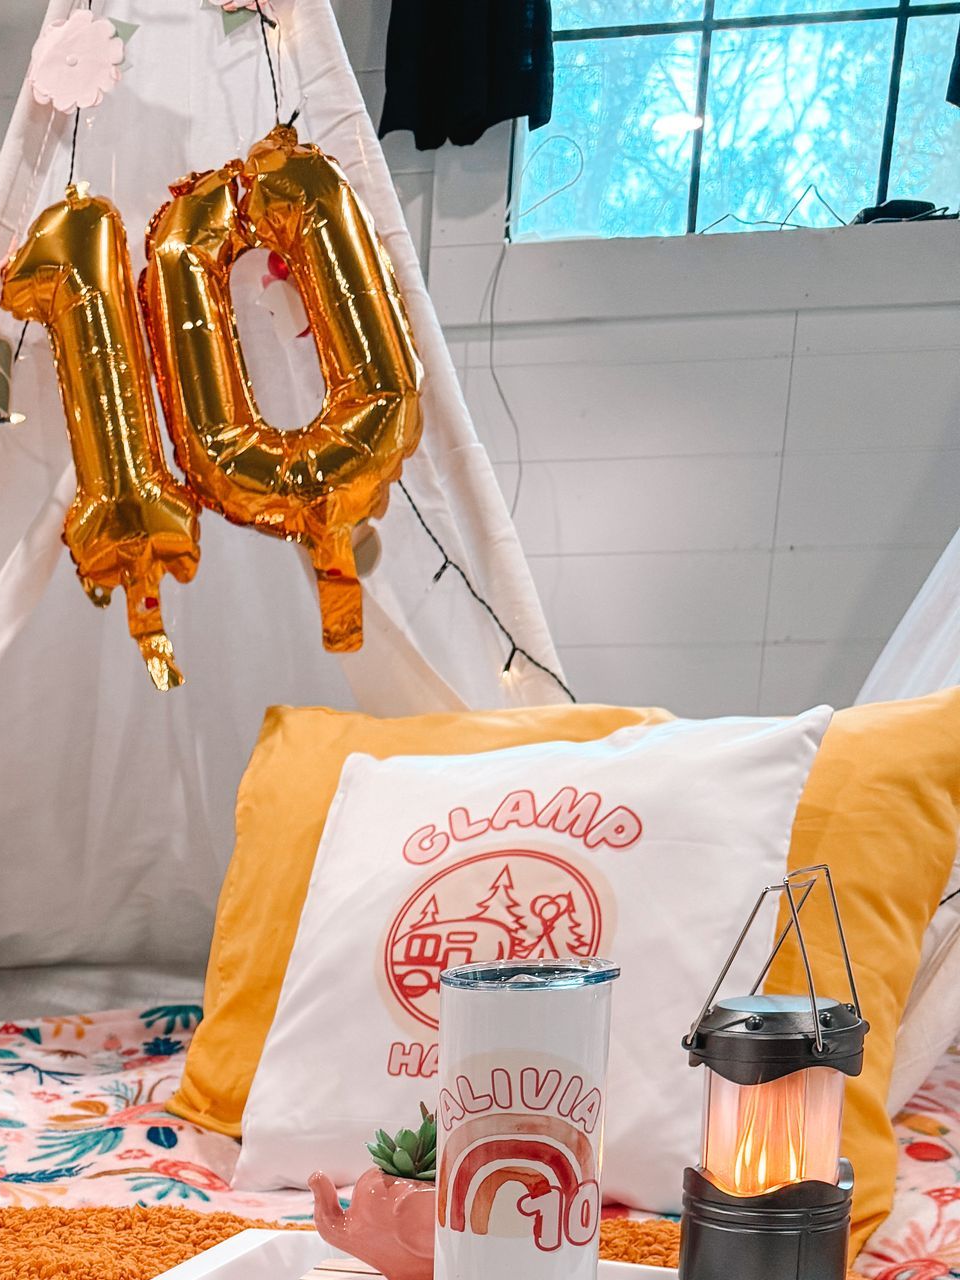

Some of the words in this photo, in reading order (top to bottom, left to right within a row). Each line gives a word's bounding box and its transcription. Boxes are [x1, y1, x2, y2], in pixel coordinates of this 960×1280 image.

[402, 786, 643, 865] GLAMP
[440, 1067, 602, 1134] ALIVIA
[516, 1179, 600, 1251] 10
